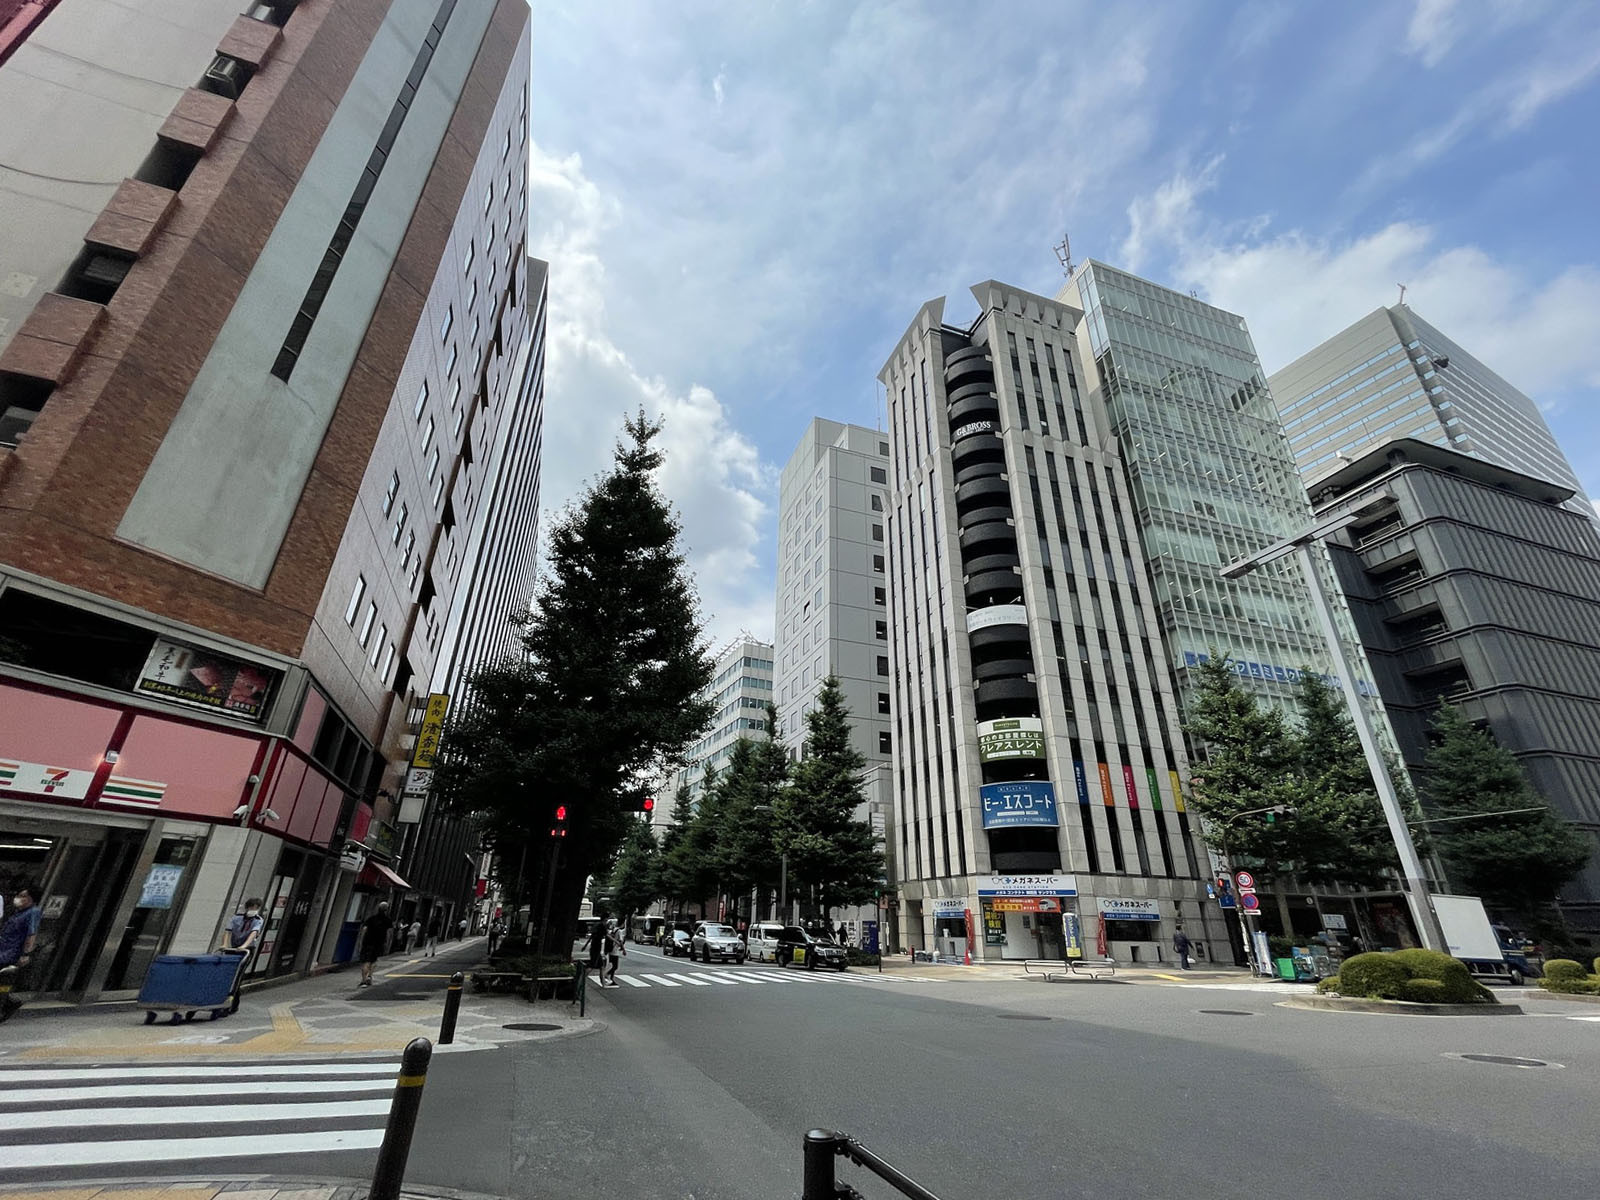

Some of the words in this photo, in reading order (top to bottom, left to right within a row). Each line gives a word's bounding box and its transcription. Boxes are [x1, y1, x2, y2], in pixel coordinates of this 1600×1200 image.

[980, 740, 1042, 753] クレアスレント
[43, 768, 70, 793] 7
[984, 794, 1052, 812] ビー・エスコート
[1012, 877, 1059, 885] メガネスーパー
[1119, 900, 1153, 908] メガネスーパー
